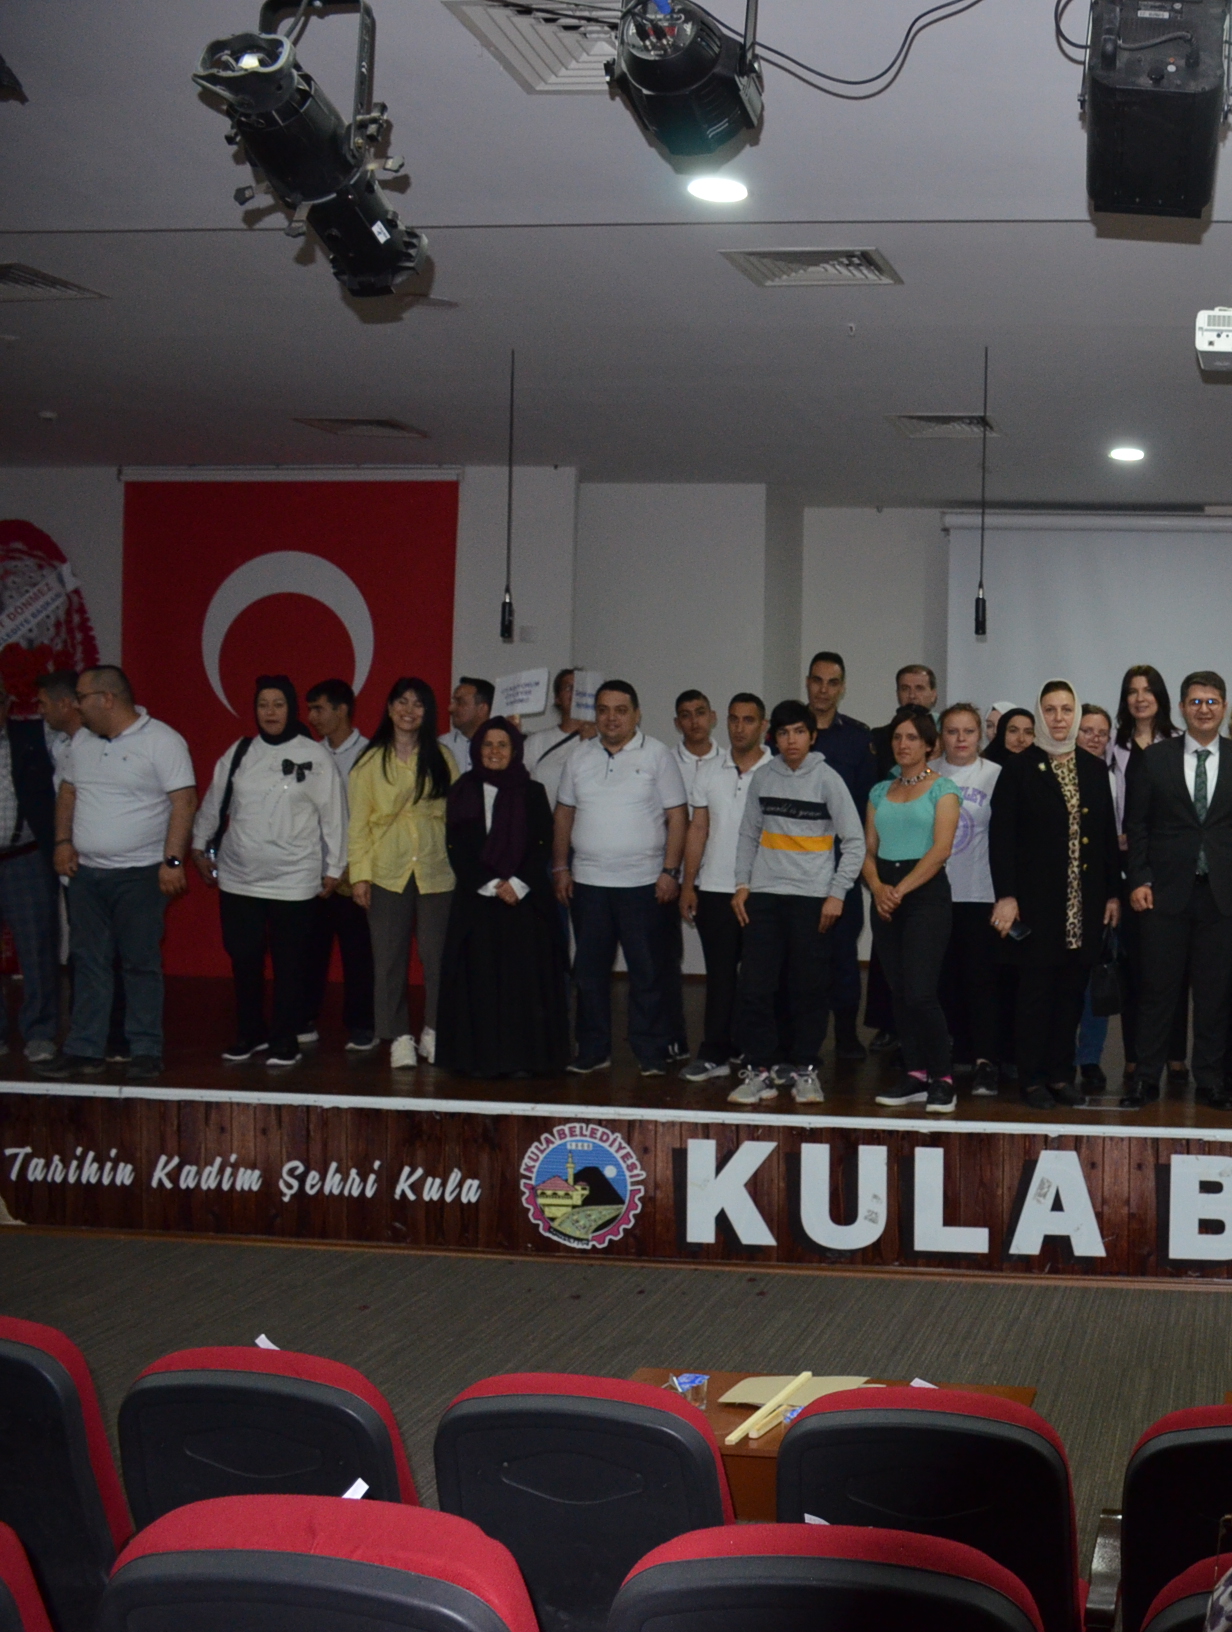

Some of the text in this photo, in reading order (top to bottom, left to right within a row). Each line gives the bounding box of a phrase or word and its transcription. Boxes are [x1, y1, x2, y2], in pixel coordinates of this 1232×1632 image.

[5, 1146, 482, 1204] Tarihin Kadim Şehri Kula
[523, 1136, 555, 1175] KULA
[686, 1138, 1107, 1257] KULA
